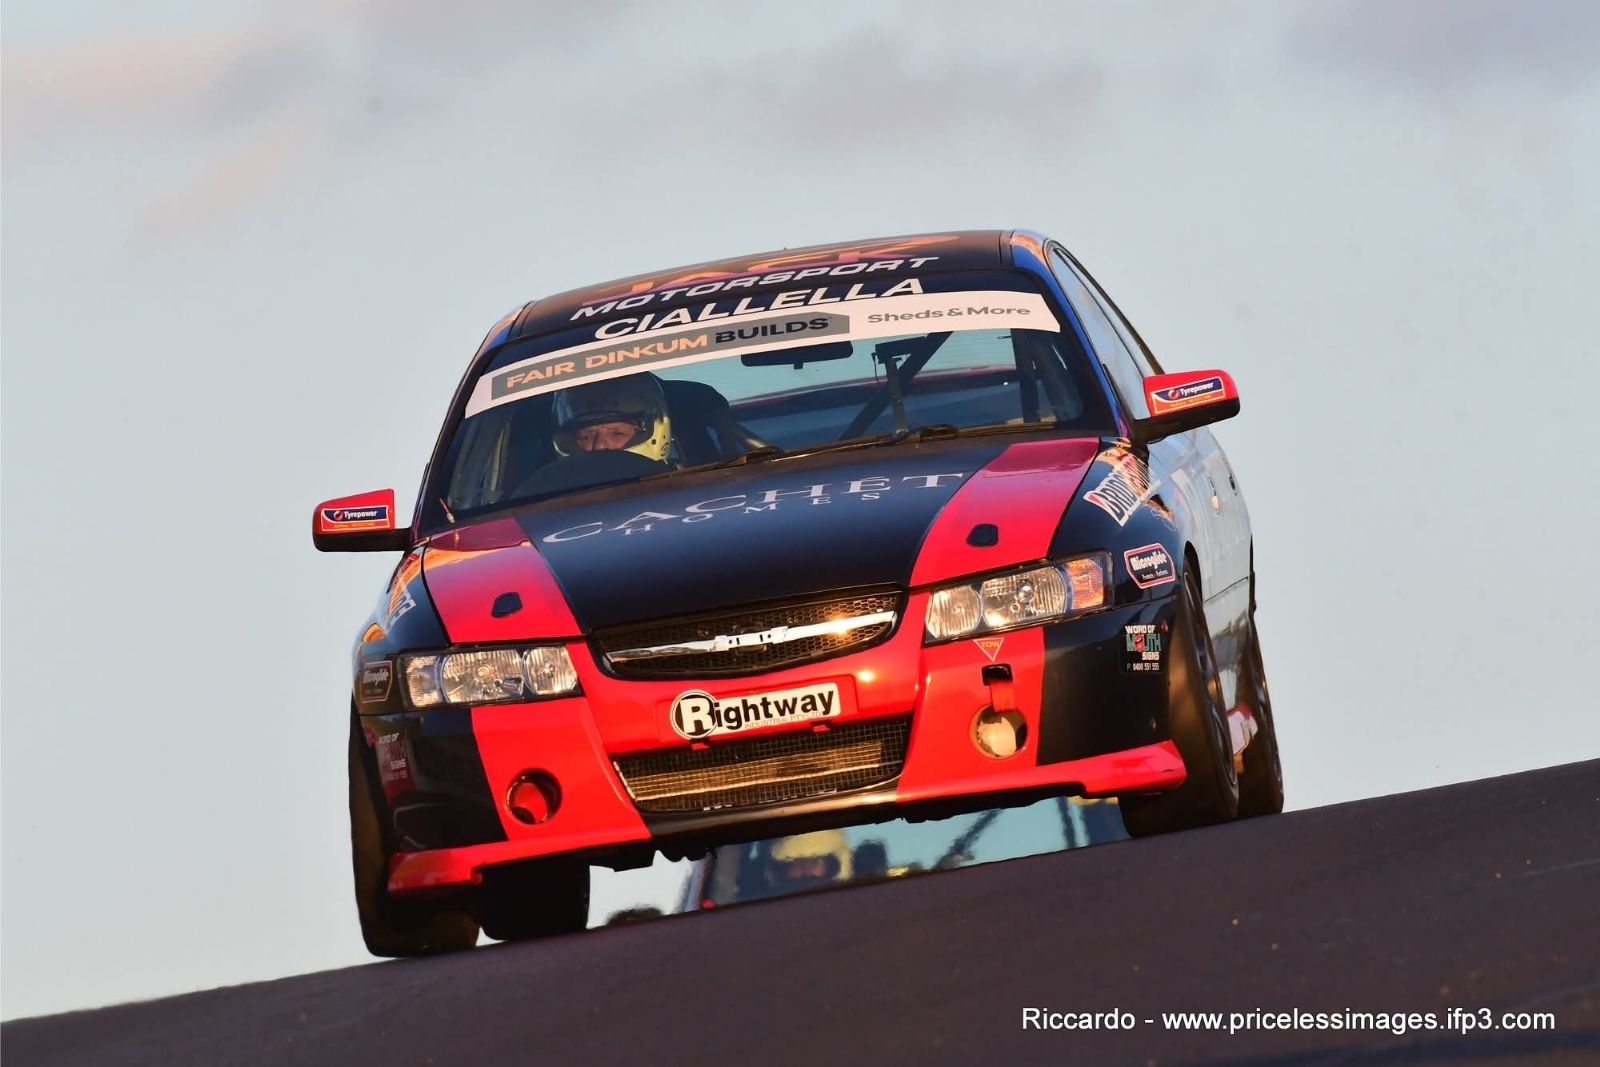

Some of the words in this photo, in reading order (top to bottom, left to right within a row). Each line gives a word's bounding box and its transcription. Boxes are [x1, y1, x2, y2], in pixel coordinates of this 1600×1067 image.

[570, 256, 940, 321] MOTORSPORT
[594, 278, 924, 340] CIALLELLA
[867, 308, 944, 324] Sheds
[946, 308, 963, 317] &
[966, 305, 1031, 317] More
[506, 361, 576, 389] FAIR
[585, 334, 709, 369] DINKUM
[715, 316, 831, 344] BUILDS
[1179, 382, 1214, 397] Tyrepower
[343, 510, 378, 520] Tyrepower
[542, 472, 964, 543] CACHET
[622, 492, 881, 536] HOMES
[1125, 624, 1147, 634] WORD
[1147, 624, 1156, 634] OF
[679, 690, 834, 734] Rightway
